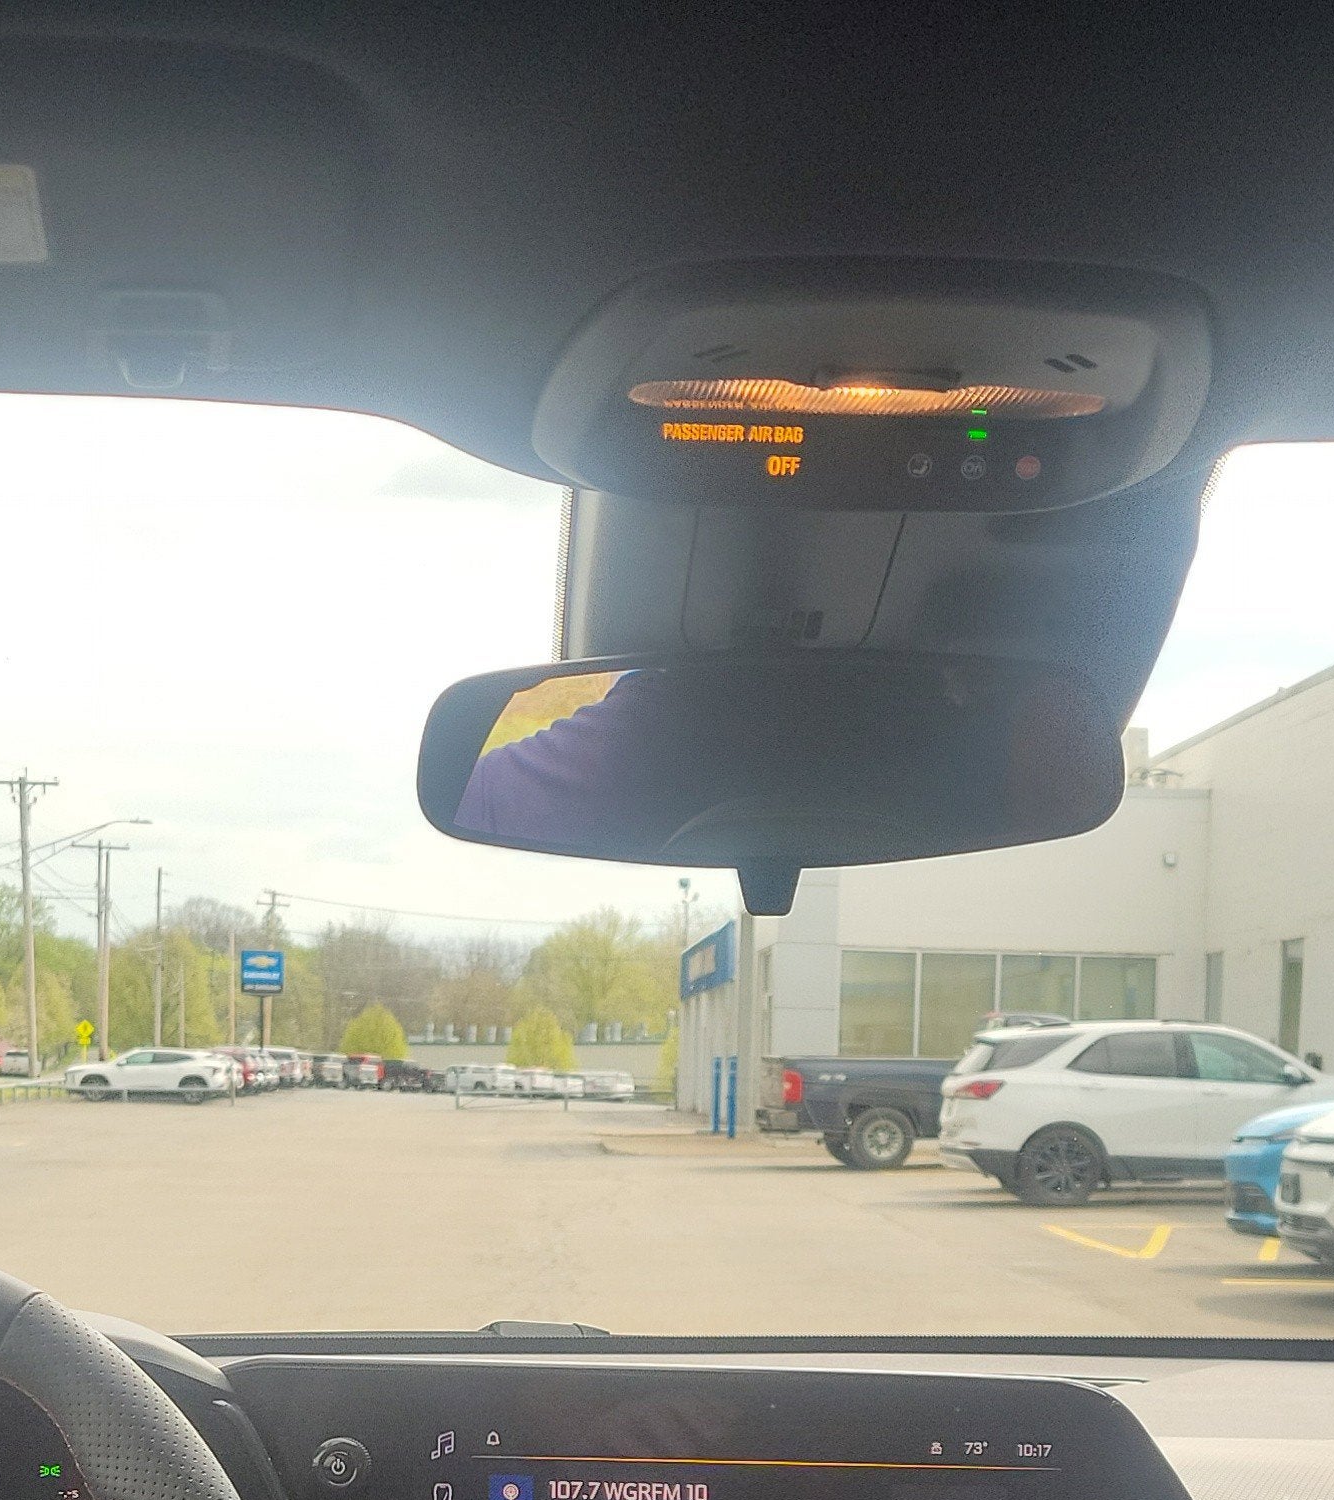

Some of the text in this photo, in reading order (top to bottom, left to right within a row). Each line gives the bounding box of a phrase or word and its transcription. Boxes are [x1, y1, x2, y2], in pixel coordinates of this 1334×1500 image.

[663, 423, 804, 443] PASSENGER AIR BAG
[767, 455, 802, 475] OFF
[964, 1441, 1053, 1457] 73° 10:17
[549, 1480, 600, 1500] 107.7
